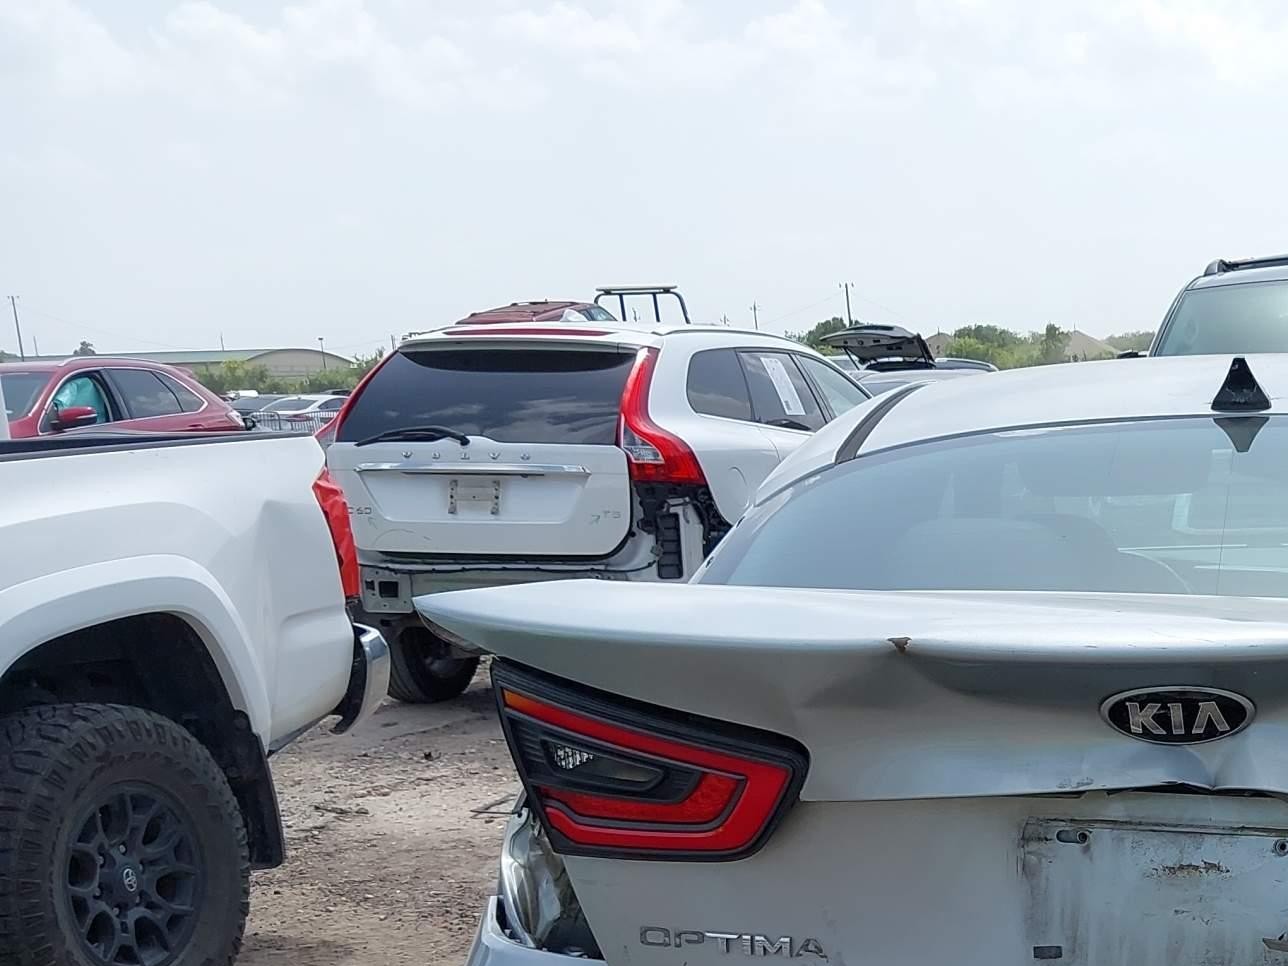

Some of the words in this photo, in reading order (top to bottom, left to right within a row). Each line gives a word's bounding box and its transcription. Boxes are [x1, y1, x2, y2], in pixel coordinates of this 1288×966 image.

[401, 450, 531, 461] VOLVO
[1125, 701, 1231, 735] KIA
[639, 925, 829, 960] OPTIMA
